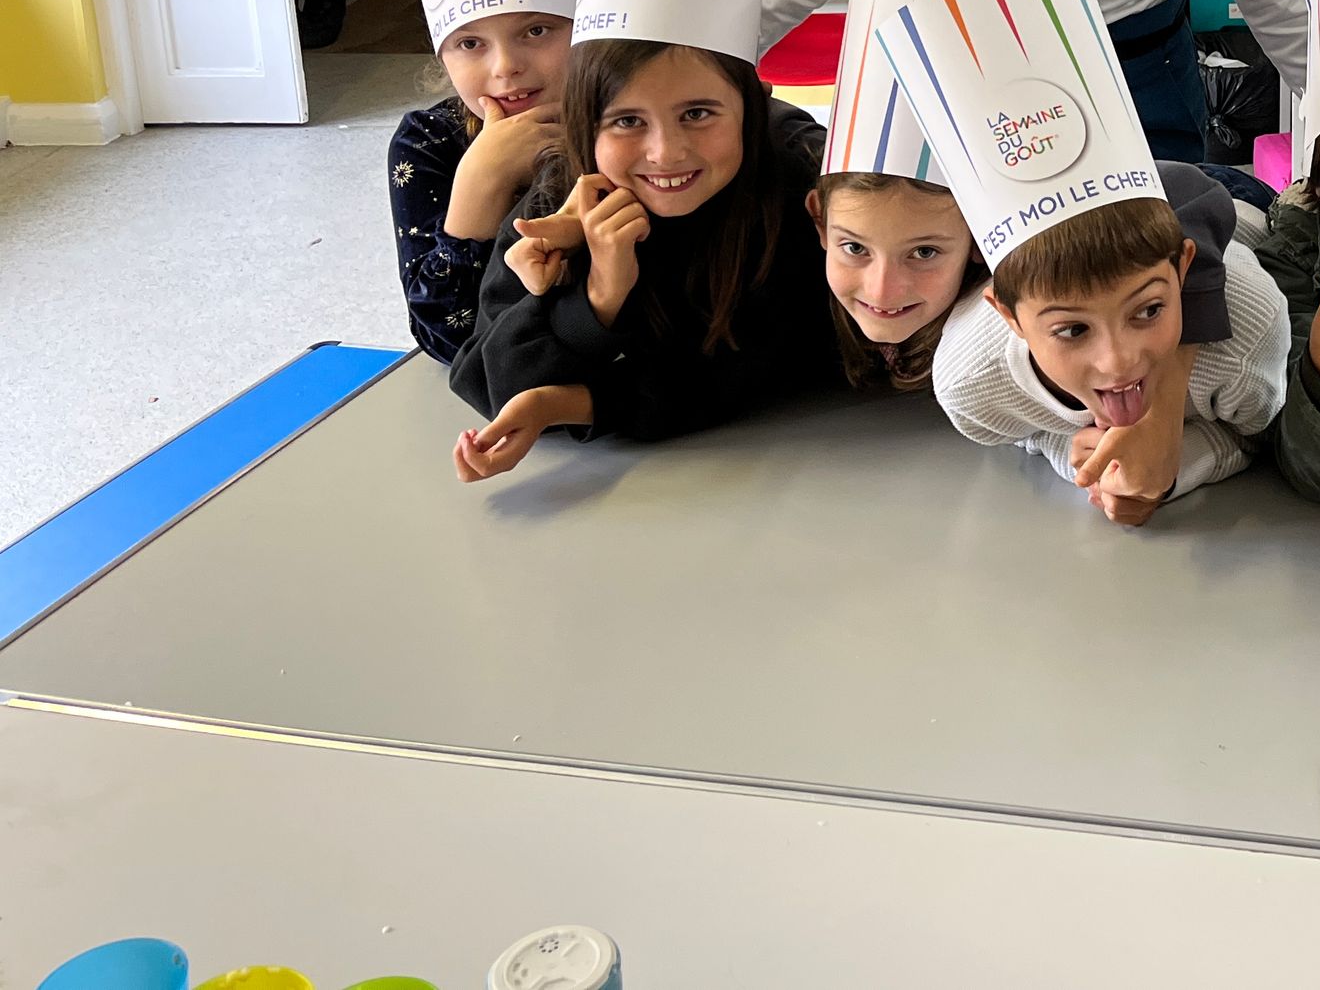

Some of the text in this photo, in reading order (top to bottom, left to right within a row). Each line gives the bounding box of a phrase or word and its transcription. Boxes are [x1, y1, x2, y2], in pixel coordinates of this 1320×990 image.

[443, 7, 457, 27] LE
[582, 12, 617, 32] CHEF
[986, 112, 1010, 128] LA
[993, 105, 1066, 142] SEMAINE
[998, 134, 1022, 154] DU
[1005, 135, 1055, 166] GOÛT
[983, 217, 1014, 256] C'EST
[1019, 192, 1065, 227] MOI
[1069, 179, 1100, 202] LE
[1103, 171, 1149, 191] CHEF
